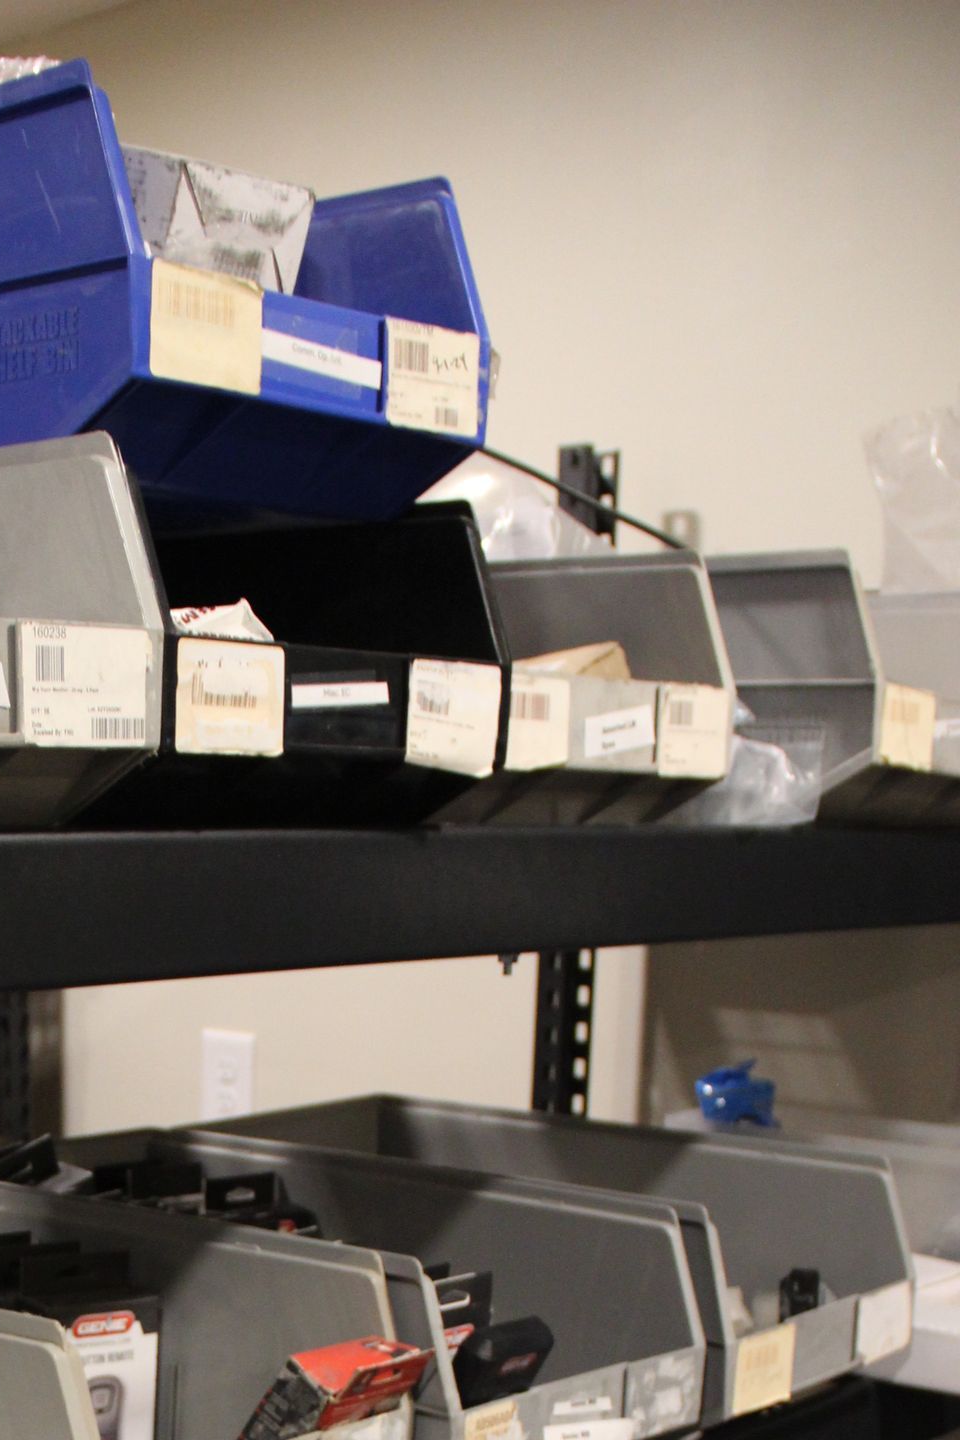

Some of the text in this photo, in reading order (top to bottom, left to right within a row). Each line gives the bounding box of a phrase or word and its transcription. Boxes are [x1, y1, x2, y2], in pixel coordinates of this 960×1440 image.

[46, 339, 80, 374] BIN
[33, 626, 67, 640] 160238
[77, 1315, 129, 1336] GENIE
